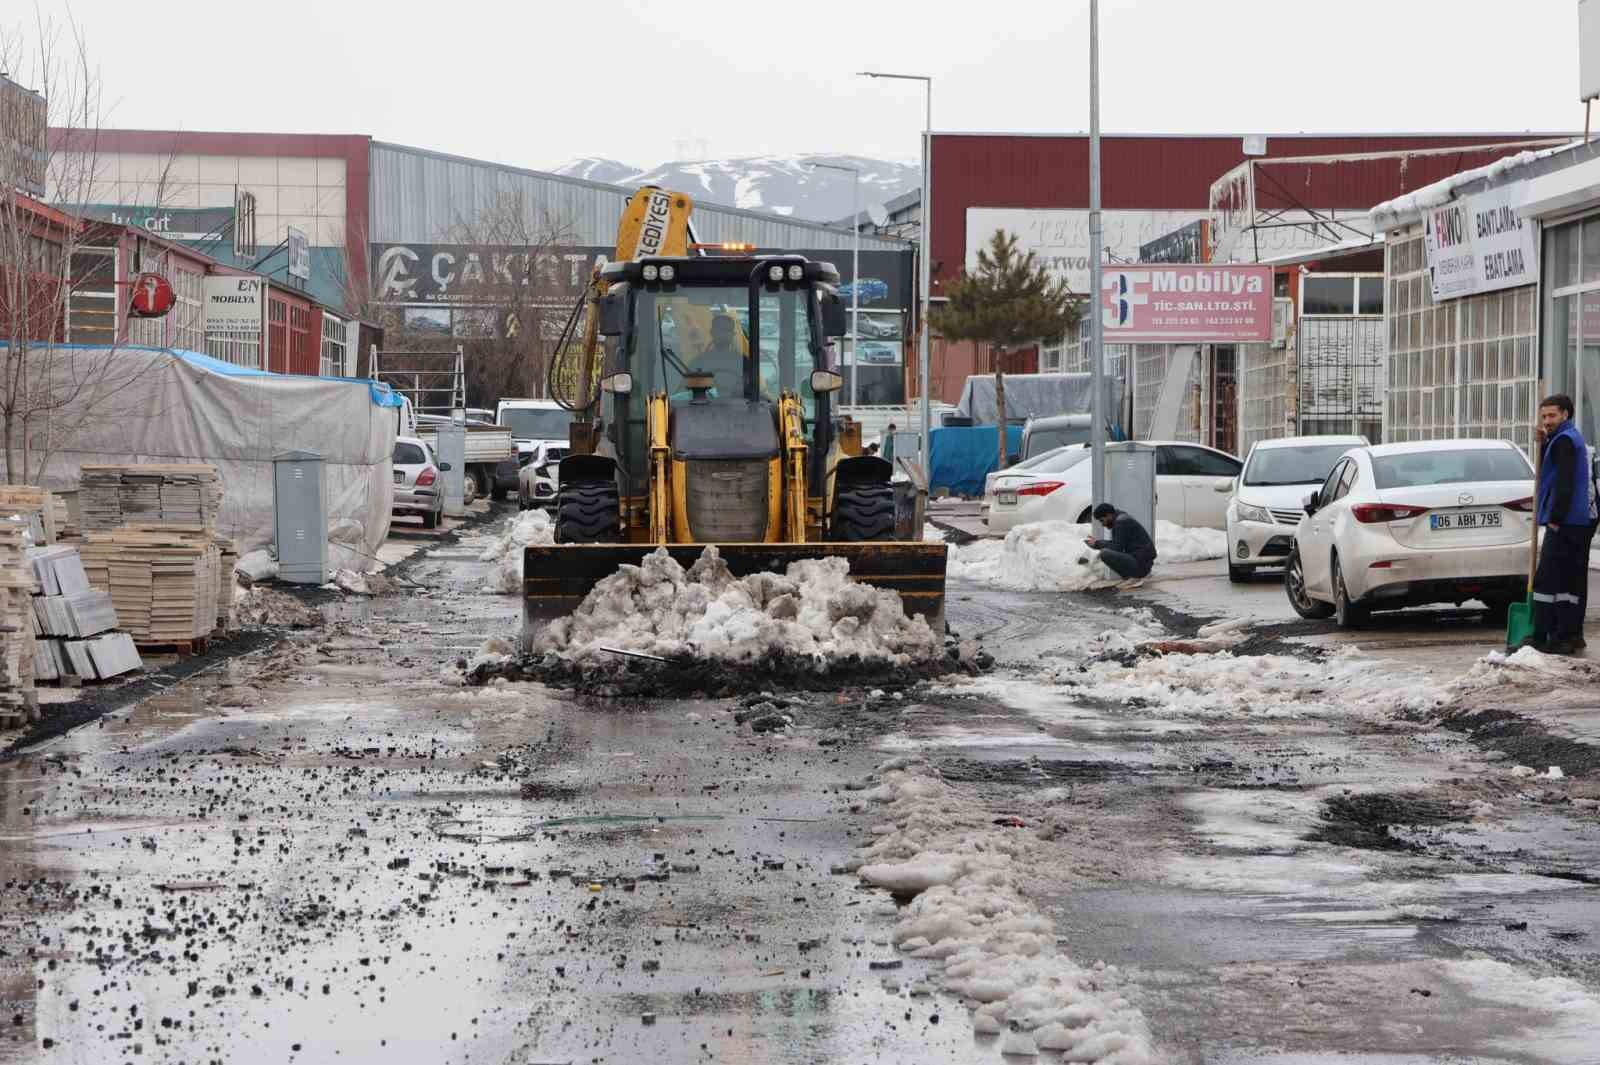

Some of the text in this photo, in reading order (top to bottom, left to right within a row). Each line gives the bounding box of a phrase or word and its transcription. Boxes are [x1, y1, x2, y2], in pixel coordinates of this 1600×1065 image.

[1476, 205, 1515, 238] BANTLAMA
[1484, 248, 1526, 281] EBATLAMA
[1152, 271, 1263, 294] Mobilya
[1438, 513, 1500, 528] 06 ABH 795
